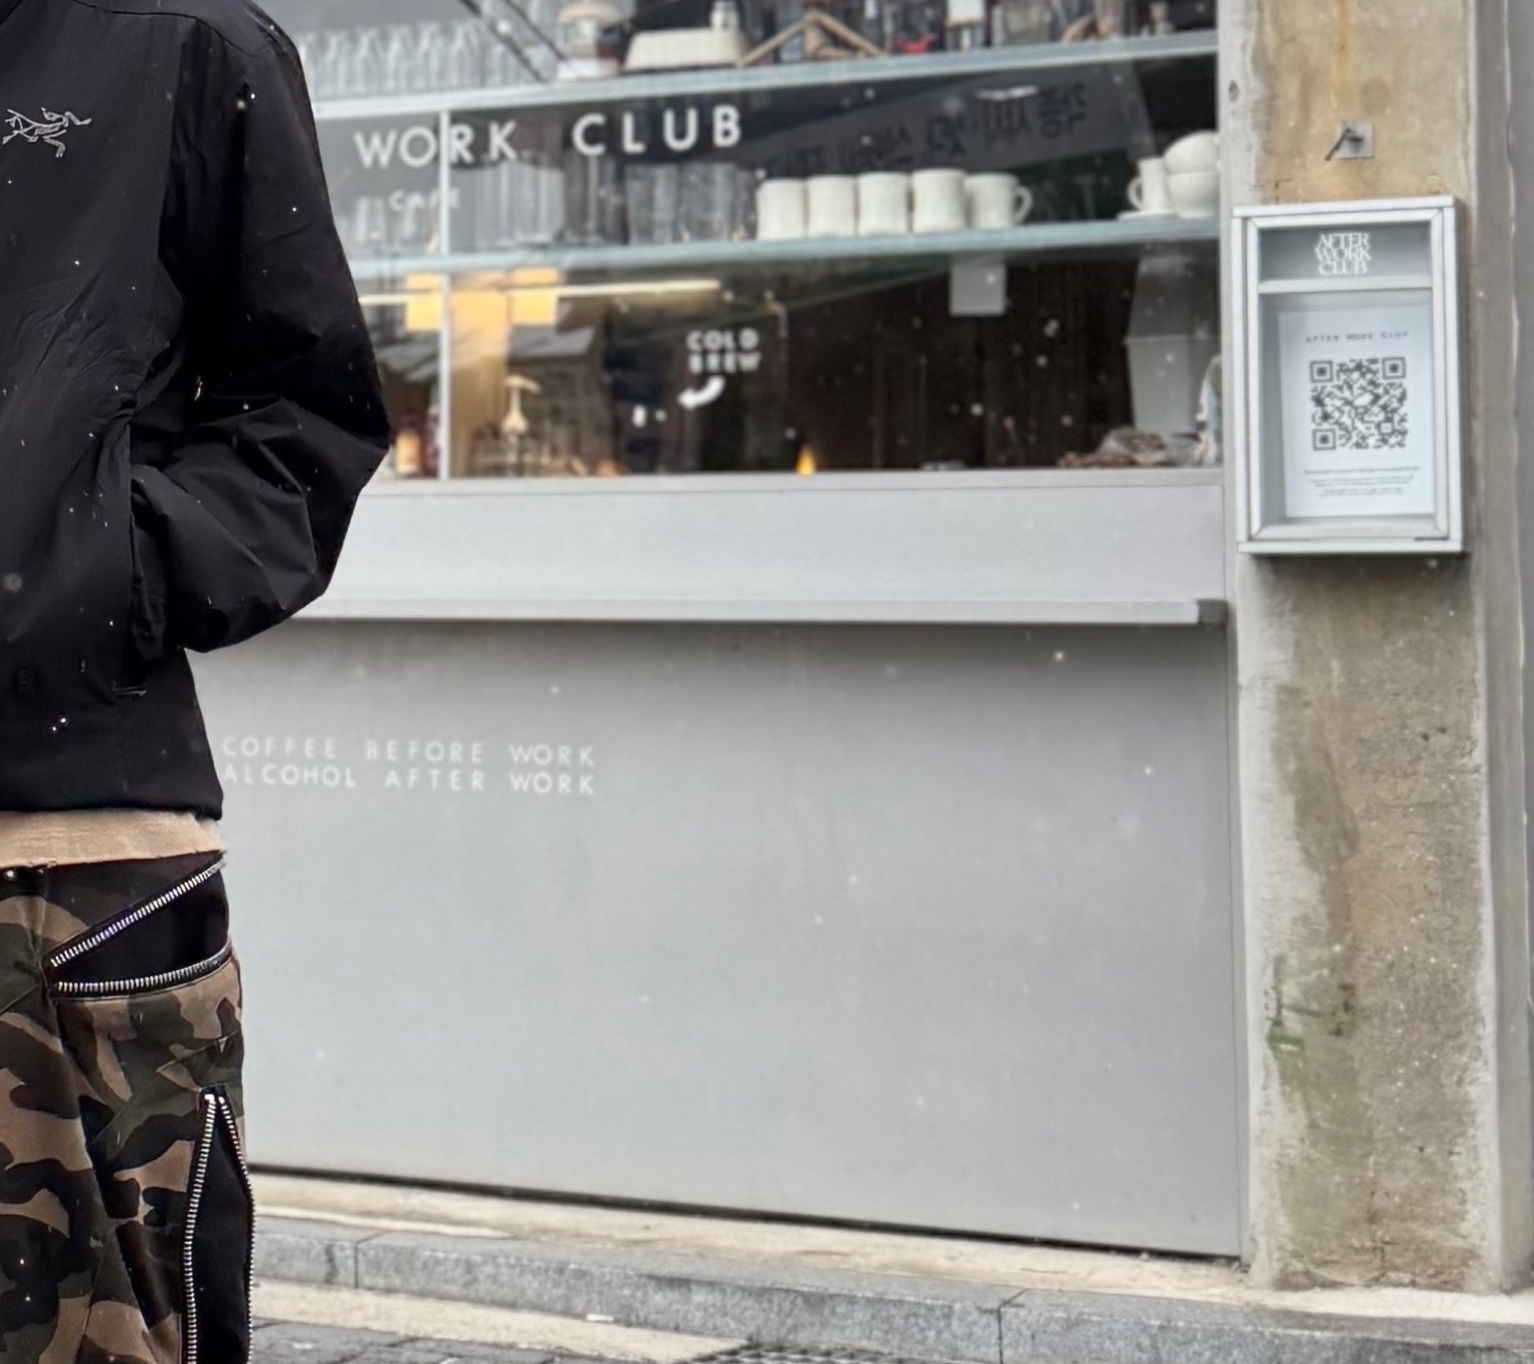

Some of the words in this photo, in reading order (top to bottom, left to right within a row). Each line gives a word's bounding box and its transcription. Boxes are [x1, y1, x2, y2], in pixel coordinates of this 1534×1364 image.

[354, 120, 517, 168] WORK
[572, 104, 741, 157] CLUB
[1317, 231, 1370, 250] AFTER
[1314, 246, 1372, 262] WORK
[1318, 259, 1369, 276] CLUB
[222, 735, 338, 759] COFFEE
[366, 739, 484, 764] BEFORE
[508, 743, 596, 768] WORK
[221, 763, 357, 789] ALCOHOL
[384, 767, 485, 792] AFTER
[508, 771, 596, 795] WORK
